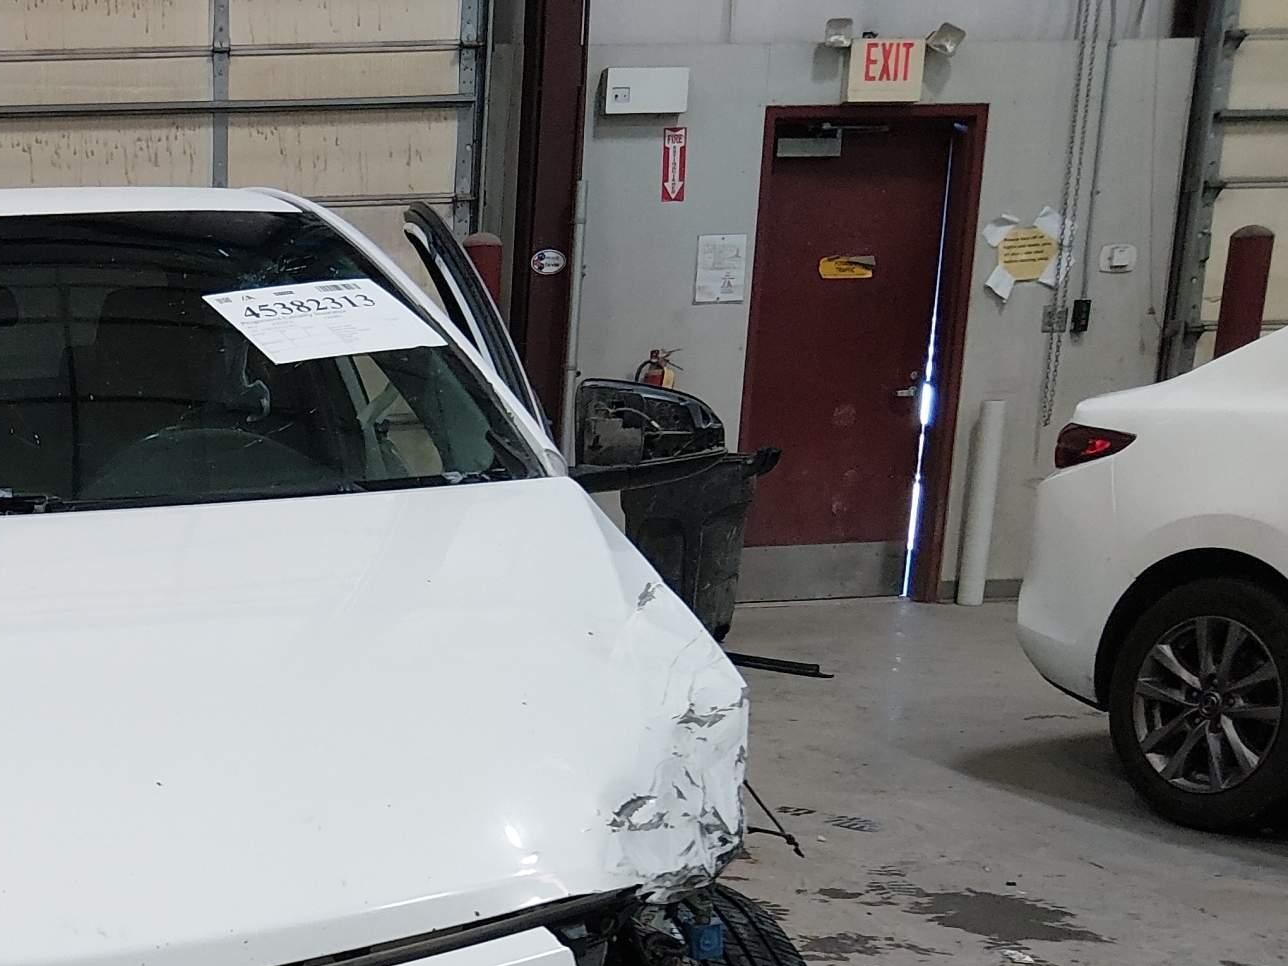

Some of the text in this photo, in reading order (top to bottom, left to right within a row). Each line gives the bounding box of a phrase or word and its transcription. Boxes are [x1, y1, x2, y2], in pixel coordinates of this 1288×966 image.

[864, 42, 915, 81] EXIT
[667, 134, 684, 145] FIRE
[244, 294, 376, 319] 45382313
